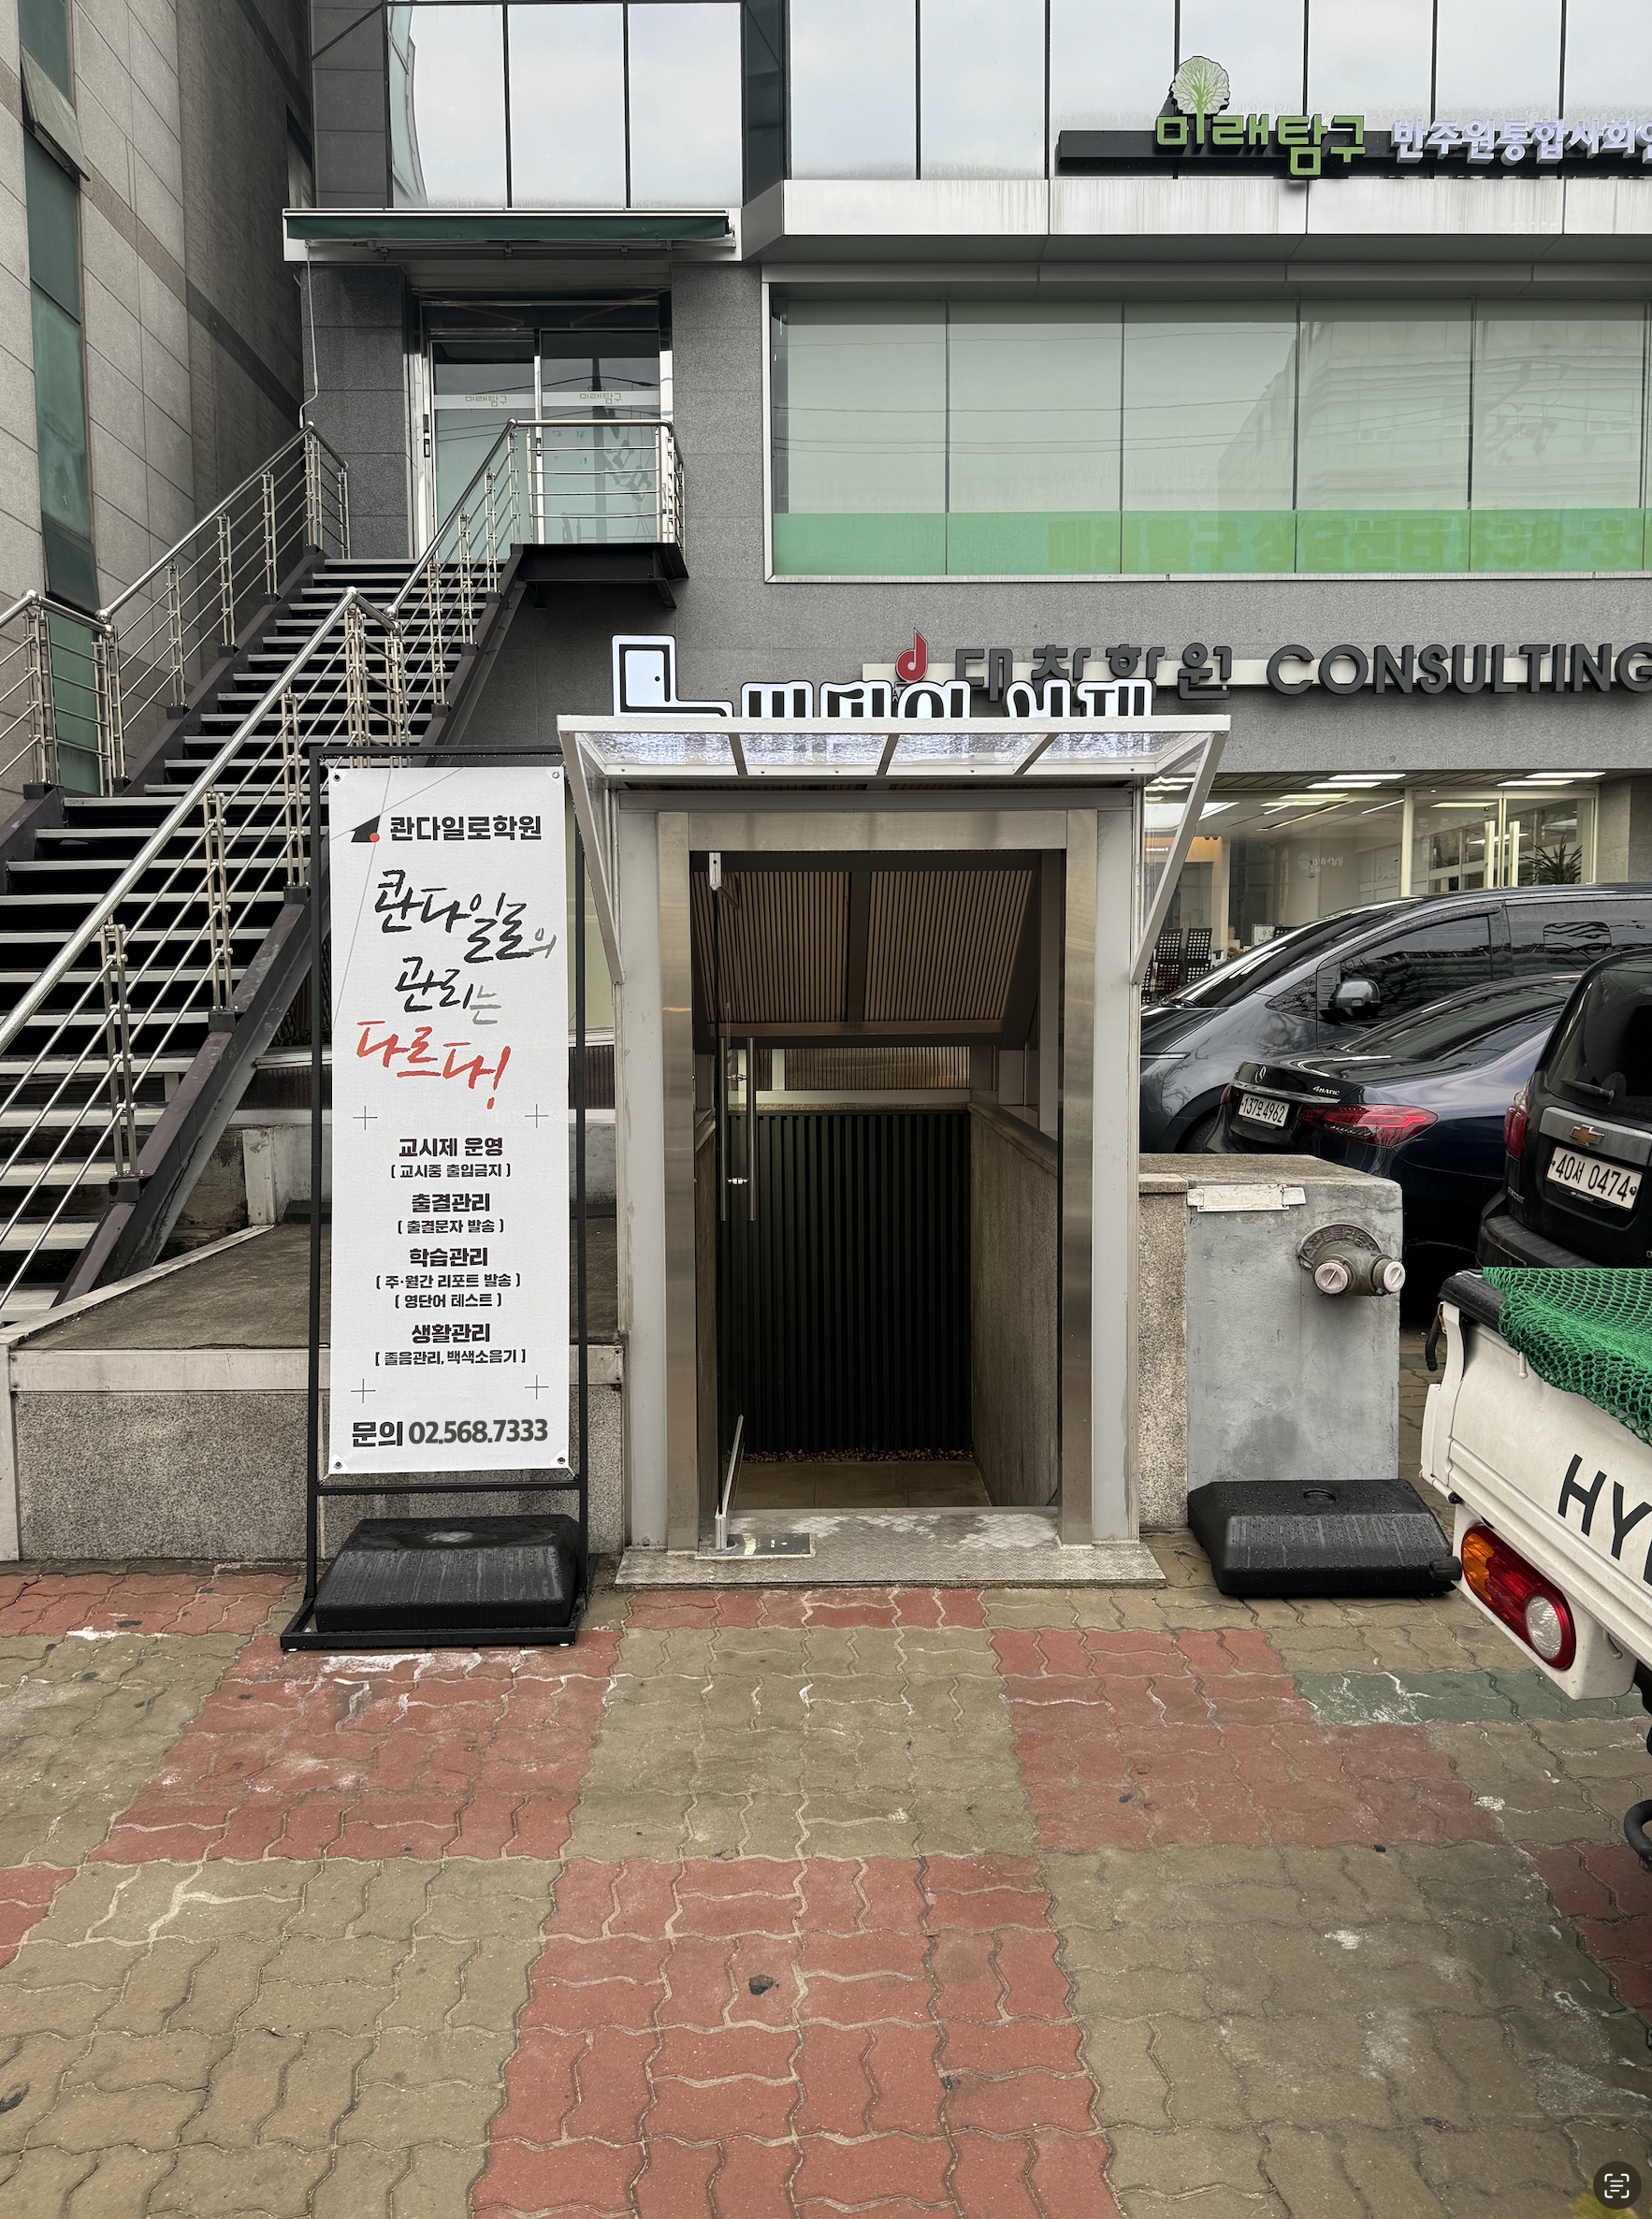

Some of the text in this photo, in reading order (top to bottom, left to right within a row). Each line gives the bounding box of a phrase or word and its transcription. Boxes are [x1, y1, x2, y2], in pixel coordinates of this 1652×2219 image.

[1155, 113, 1365, 178] 미래탐구
[465, 395, 508, 407] 미래탐구
[579, 392, 622, 404] 미래탐구
[1267, 642, 1652, 696] CONSULTING
[390, 815, 542, 842] 콴다일로학원
[356, 1020, 512, 1110] 다르다!
[399, 1137, 503, 1157] 교시제 운영
[400, 1165, 442, 1178] 교시중
[446, 1164, 501, 1177] 출입금지
[1587, 1165, 1631, 1201] 0474
[412, 1193, 490, 1212] 출결관리
[407, 1220, 463, 1234] 출결문자
[468, 1219, 495, 1233] 발송
[410, 1247, 488, 1267] 학습관리
[438, 1274, 479, 1287] 리포트
[484, 1273, 512, 1287] 발송
[404, 1295, 446, 1309] 영단어
[451, 1293, 493, 1307] 테스트
[412, 1324, 490, 1343] 생활관리
[352, 1419, 548, 1446] 문의 02.568.7333
[1558, 1454, 1652, 1588] HY
